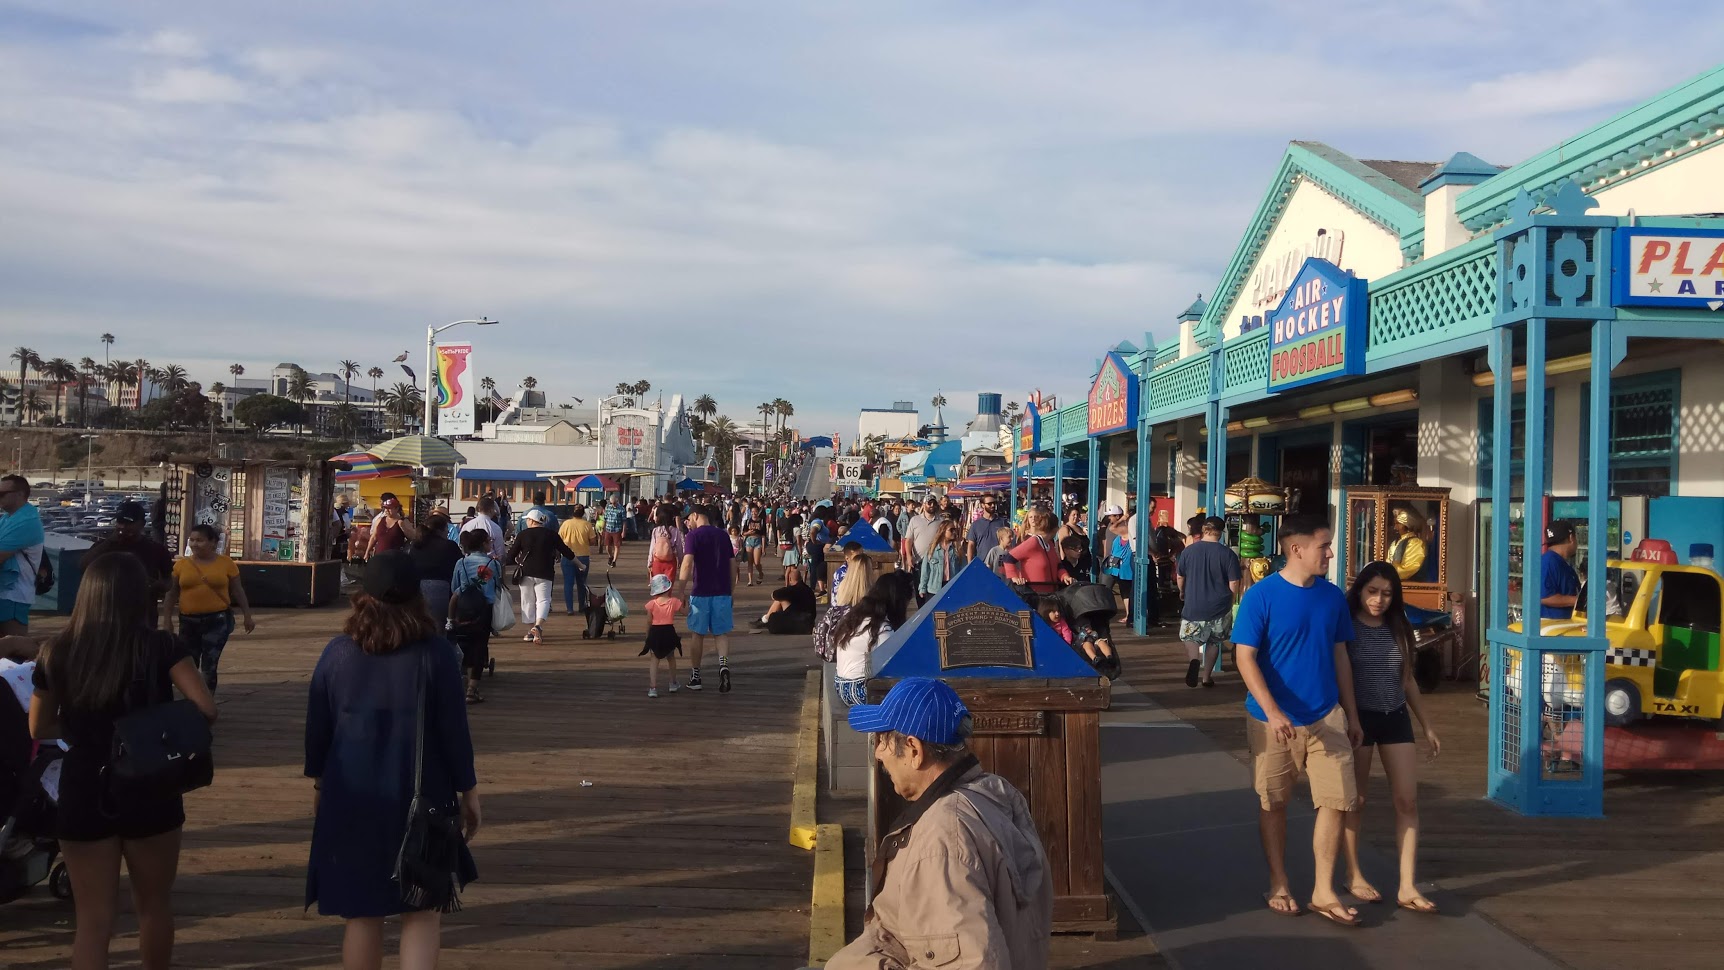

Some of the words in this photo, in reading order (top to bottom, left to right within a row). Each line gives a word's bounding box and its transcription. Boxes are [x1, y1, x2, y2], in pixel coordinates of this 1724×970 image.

[1294, 278, 1322, 311] AIR
[1274, 295, 1344, 344] HOCKEY
[1271, 333, 1344, 381] FOOSBALL
[1091, 399, 1124, 430] PRIZES
[215, 472, 227, 480] 66
[846, 466, 858, 477] 66
[212, 502, 224, 512] 66
[202, 516, 213, 525] 66
[1634, 549, 1661, 562] TAXI
[947, 617, 964, 626] SPORT
[994, 615, 1019, 626] BOATING
[1653, 702, 1699, 714] TAXI
